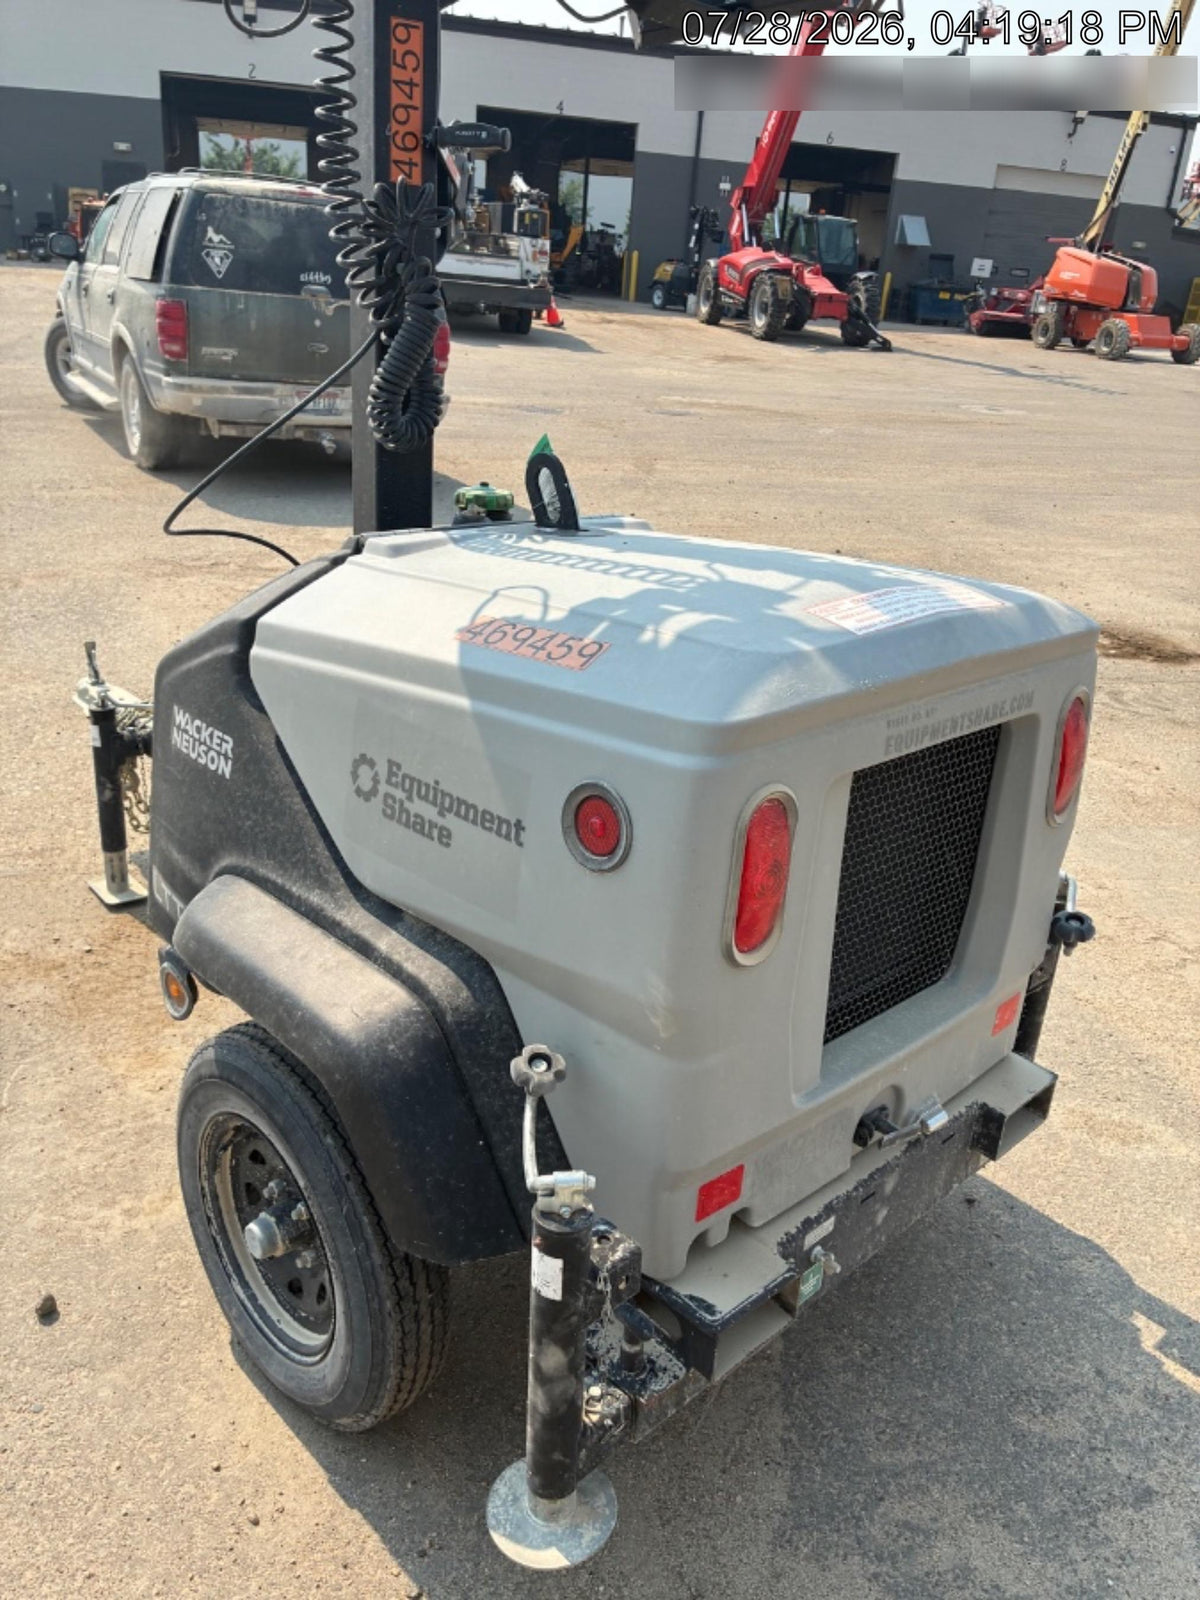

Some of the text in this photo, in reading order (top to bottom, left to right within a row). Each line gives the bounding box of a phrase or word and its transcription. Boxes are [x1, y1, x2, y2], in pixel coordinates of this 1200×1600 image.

[248, 63, 256, 79] 2
[392, 21, 420, 180] 469459
[555, 99, 564, 115] 4
[826, 130, 834, 145] 6
[465, 618, 604, 668] 469459
[172, 704, 234, 759] WACKER
[884, 689, 1035, 757] EQUIPMENTSHARE.COM
[171, 726, 232, 780] NEUSON
[381, 792, 453, 848] Share
[385, 758, 526, 848] Equipment
